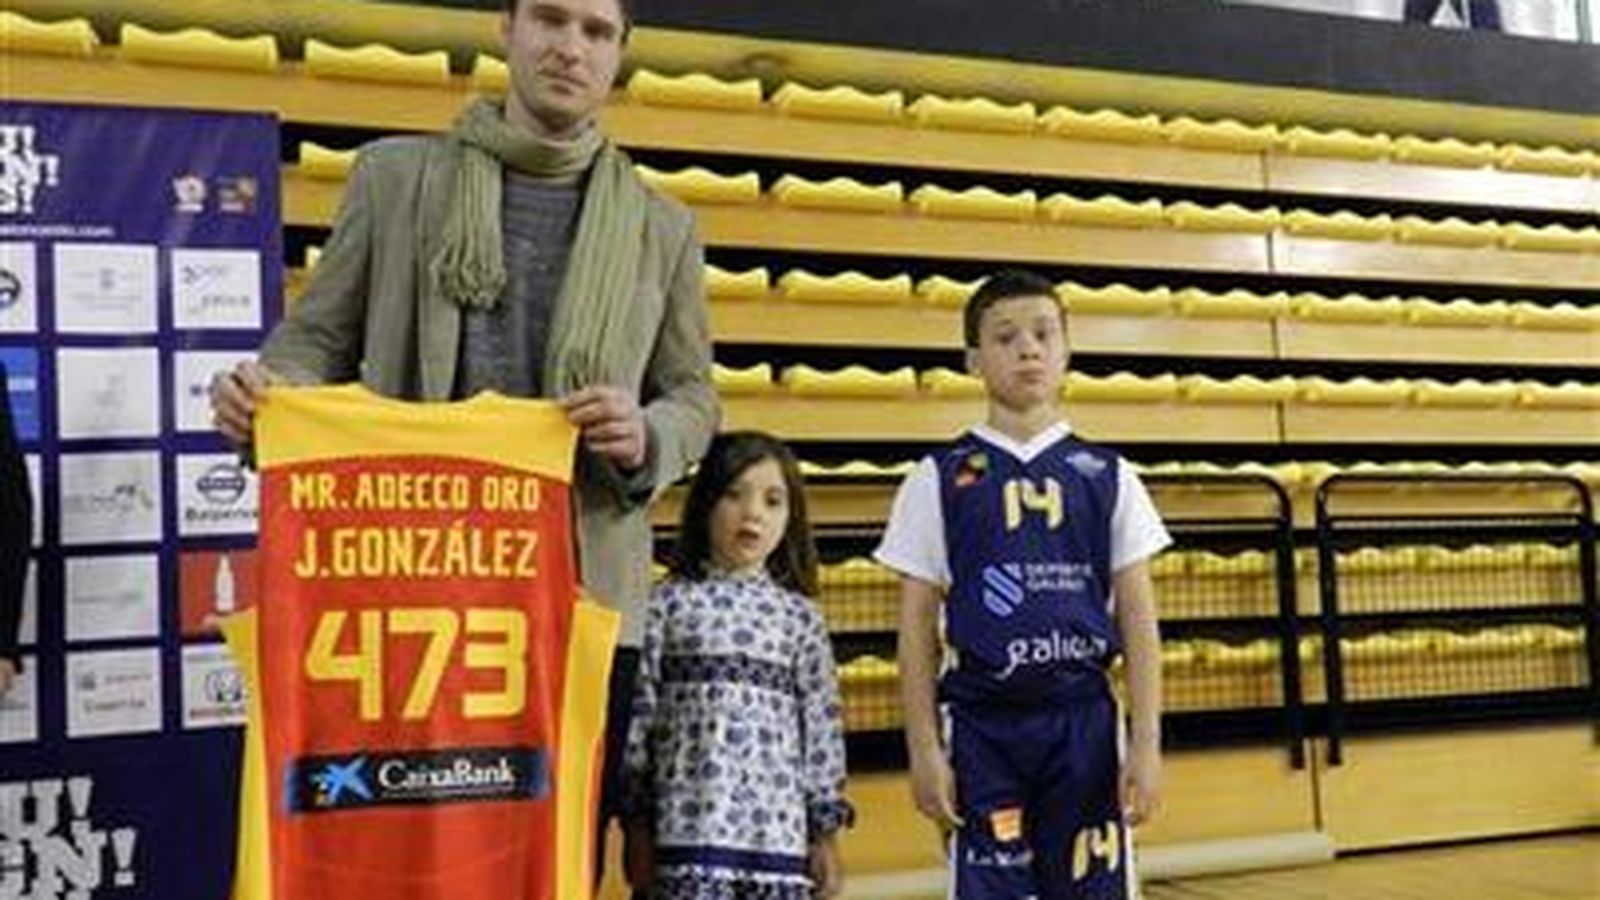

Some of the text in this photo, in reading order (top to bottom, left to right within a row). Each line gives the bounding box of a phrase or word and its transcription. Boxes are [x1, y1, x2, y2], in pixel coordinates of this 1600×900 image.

[290, 473, 541, 511] MR. ADECCO ORO
[1003, 476, 1062, 530] 14
[294, 519, 539, 578] J.GONZÁLEZ
[304, 607, 528, 720] 473
[378, 756, 515, 789] CaixaBank
[1073, 820, 1119, 880] 14
